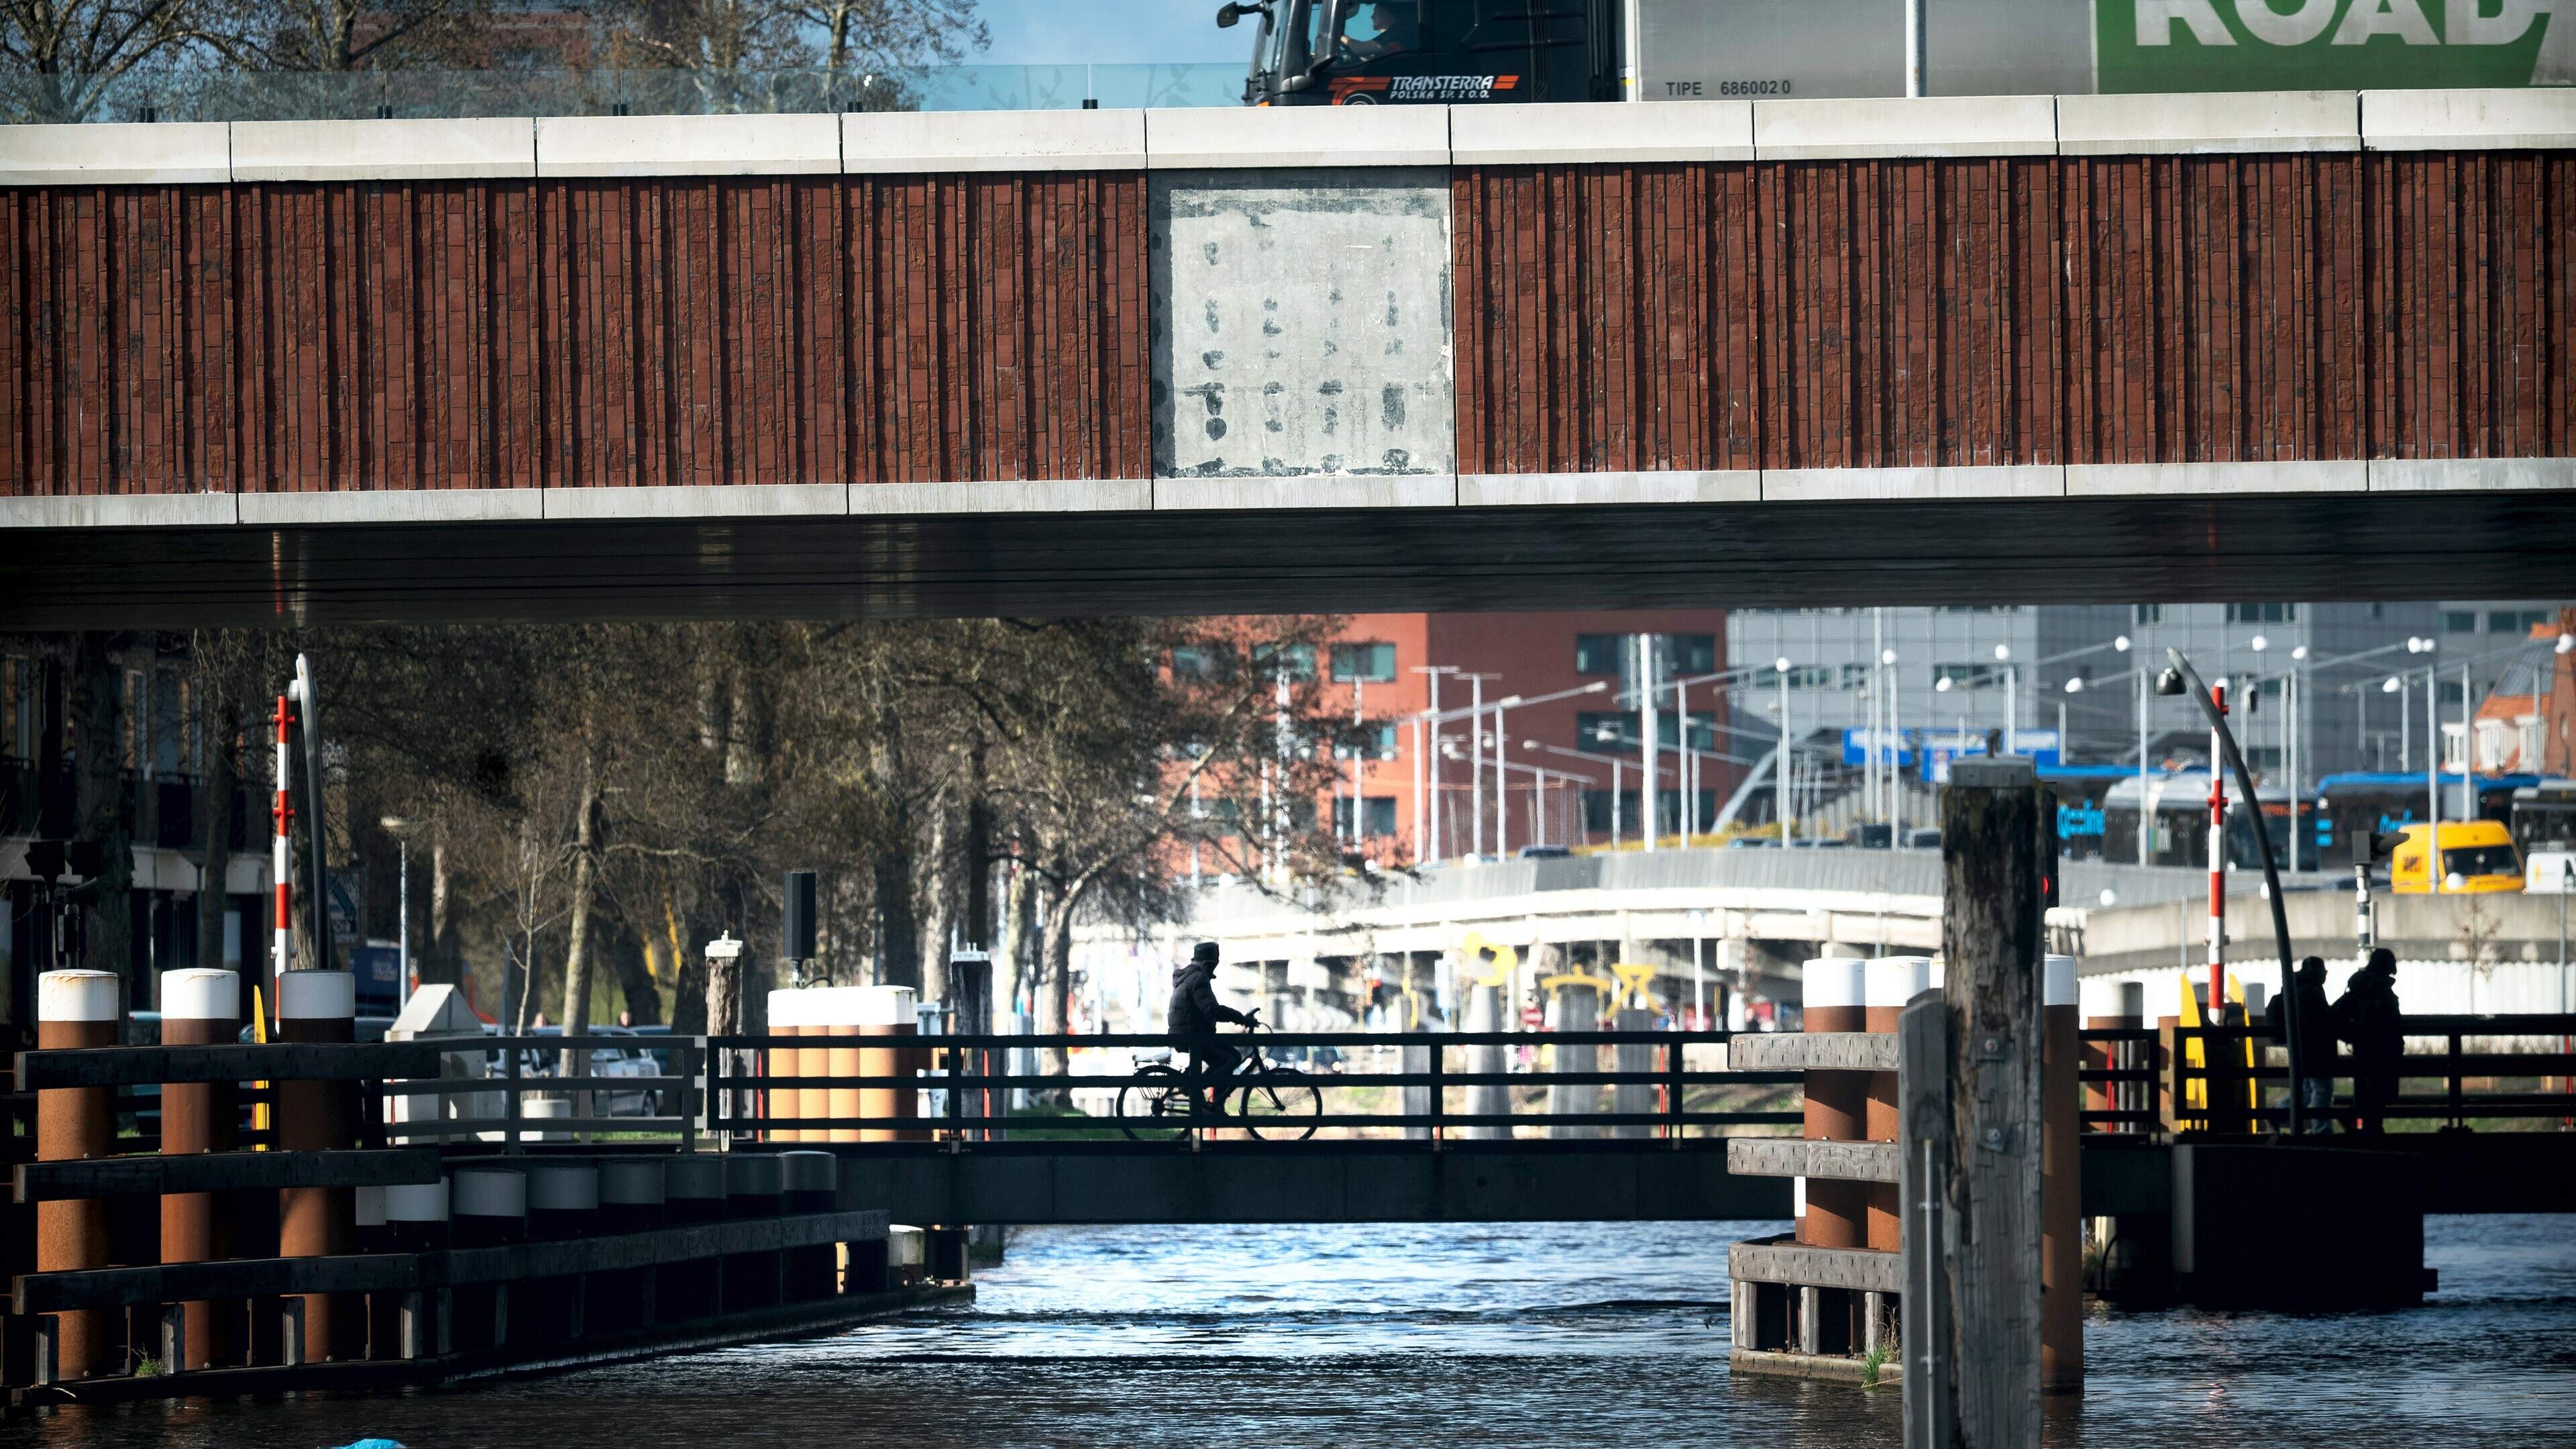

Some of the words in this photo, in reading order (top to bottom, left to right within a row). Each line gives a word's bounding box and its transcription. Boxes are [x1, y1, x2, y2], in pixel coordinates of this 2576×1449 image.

[1393, 76, 1494, 90] TRANSTERRA
[1666, 82, 1702, 95] TIPE
[1390, 91, 1434, 99] POLSKA
